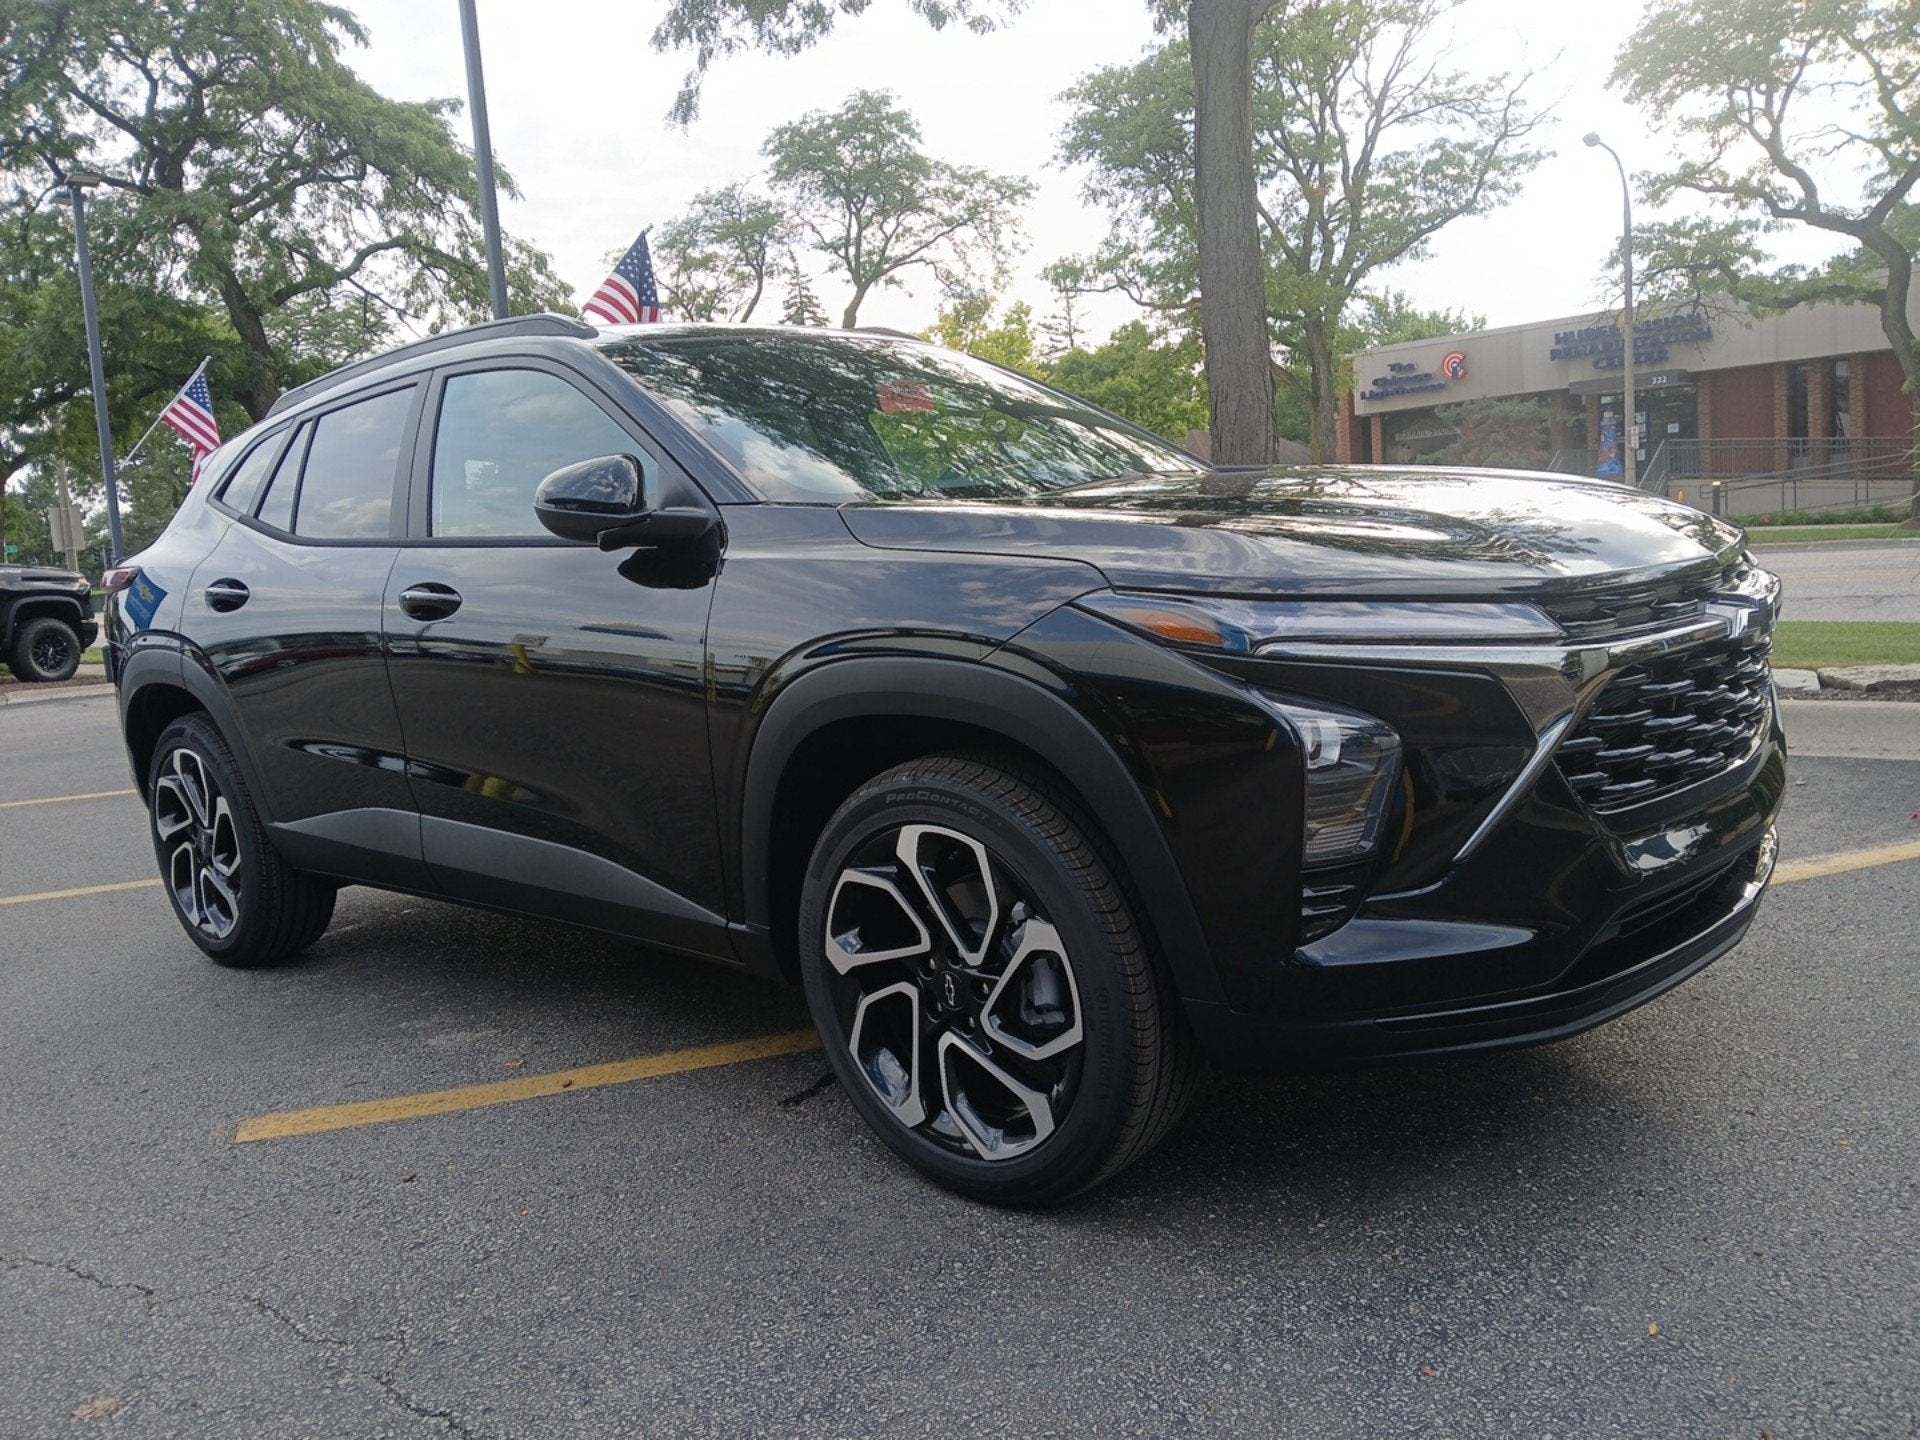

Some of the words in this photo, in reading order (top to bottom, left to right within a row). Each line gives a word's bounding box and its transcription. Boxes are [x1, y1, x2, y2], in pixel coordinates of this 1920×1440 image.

[1550, 326, 1713, 361] REHABILTATION
[1387, 362, 1416, 373] The
[1652, 375, 1667, 384] 222
[1360, 381, 1447, 401] Lighthouse
